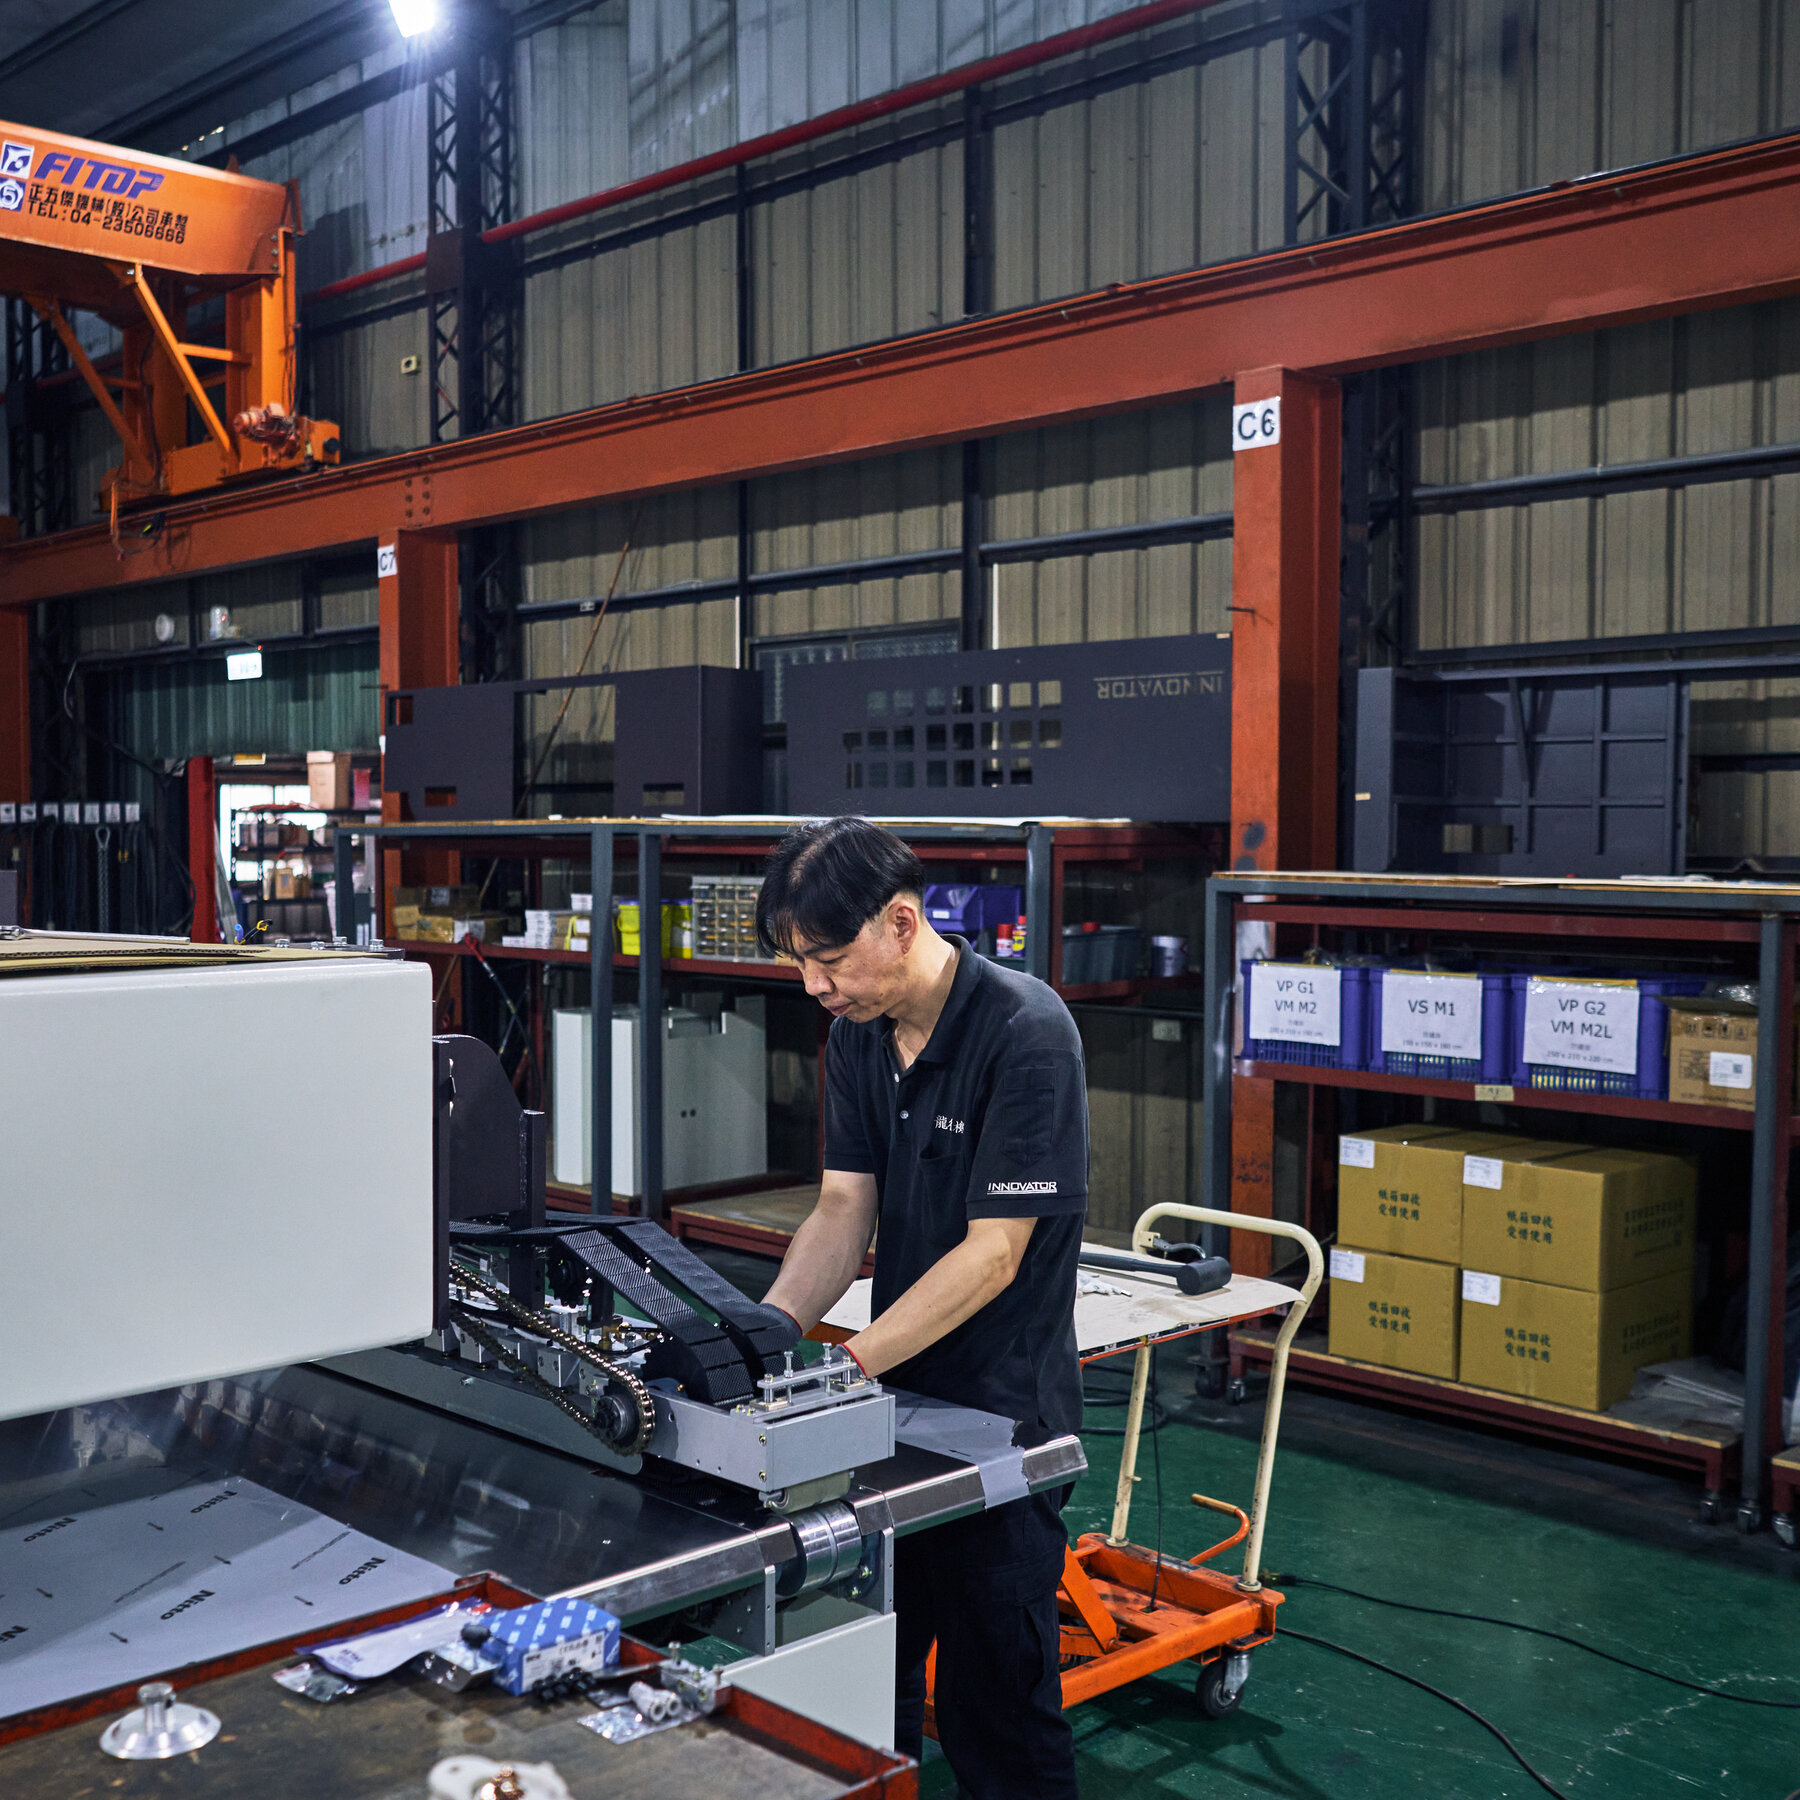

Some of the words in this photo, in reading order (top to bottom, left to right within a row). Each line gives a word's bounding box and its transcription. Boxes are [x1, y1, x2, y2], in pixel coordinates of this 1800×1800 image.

[34, 152, 165, 199] FITOP
[1238, 408, 1275, 441] C6
[380, 551, 396, 572] C7
[1276, 980, 1293, 993] VP
[1297, 981, 1314, 994] G1
[1275, 1000, 1294, 1013] VM
[1298, 1001, 1317, 1015] M2
[1408, 999, 1428, 1015] VS
[1434, 1001, 1455, 1017] M1
[1558, 999, 1579, 1013] VP
[1584, 1001, 1606, 1016] G2
[1551, 1020, 1575, 1035] VM
[1581, 1022, 1613, 1039] M2L
[987, 1181, 1058, 1194] INNOVATOR
[190, 1490, 238, 1514] Nitto
[23, 1517, 78, 1543] Nitto
[338, 1557, 387, 1585] Nitto
[160, 1589, 216, 1621] Nitto
